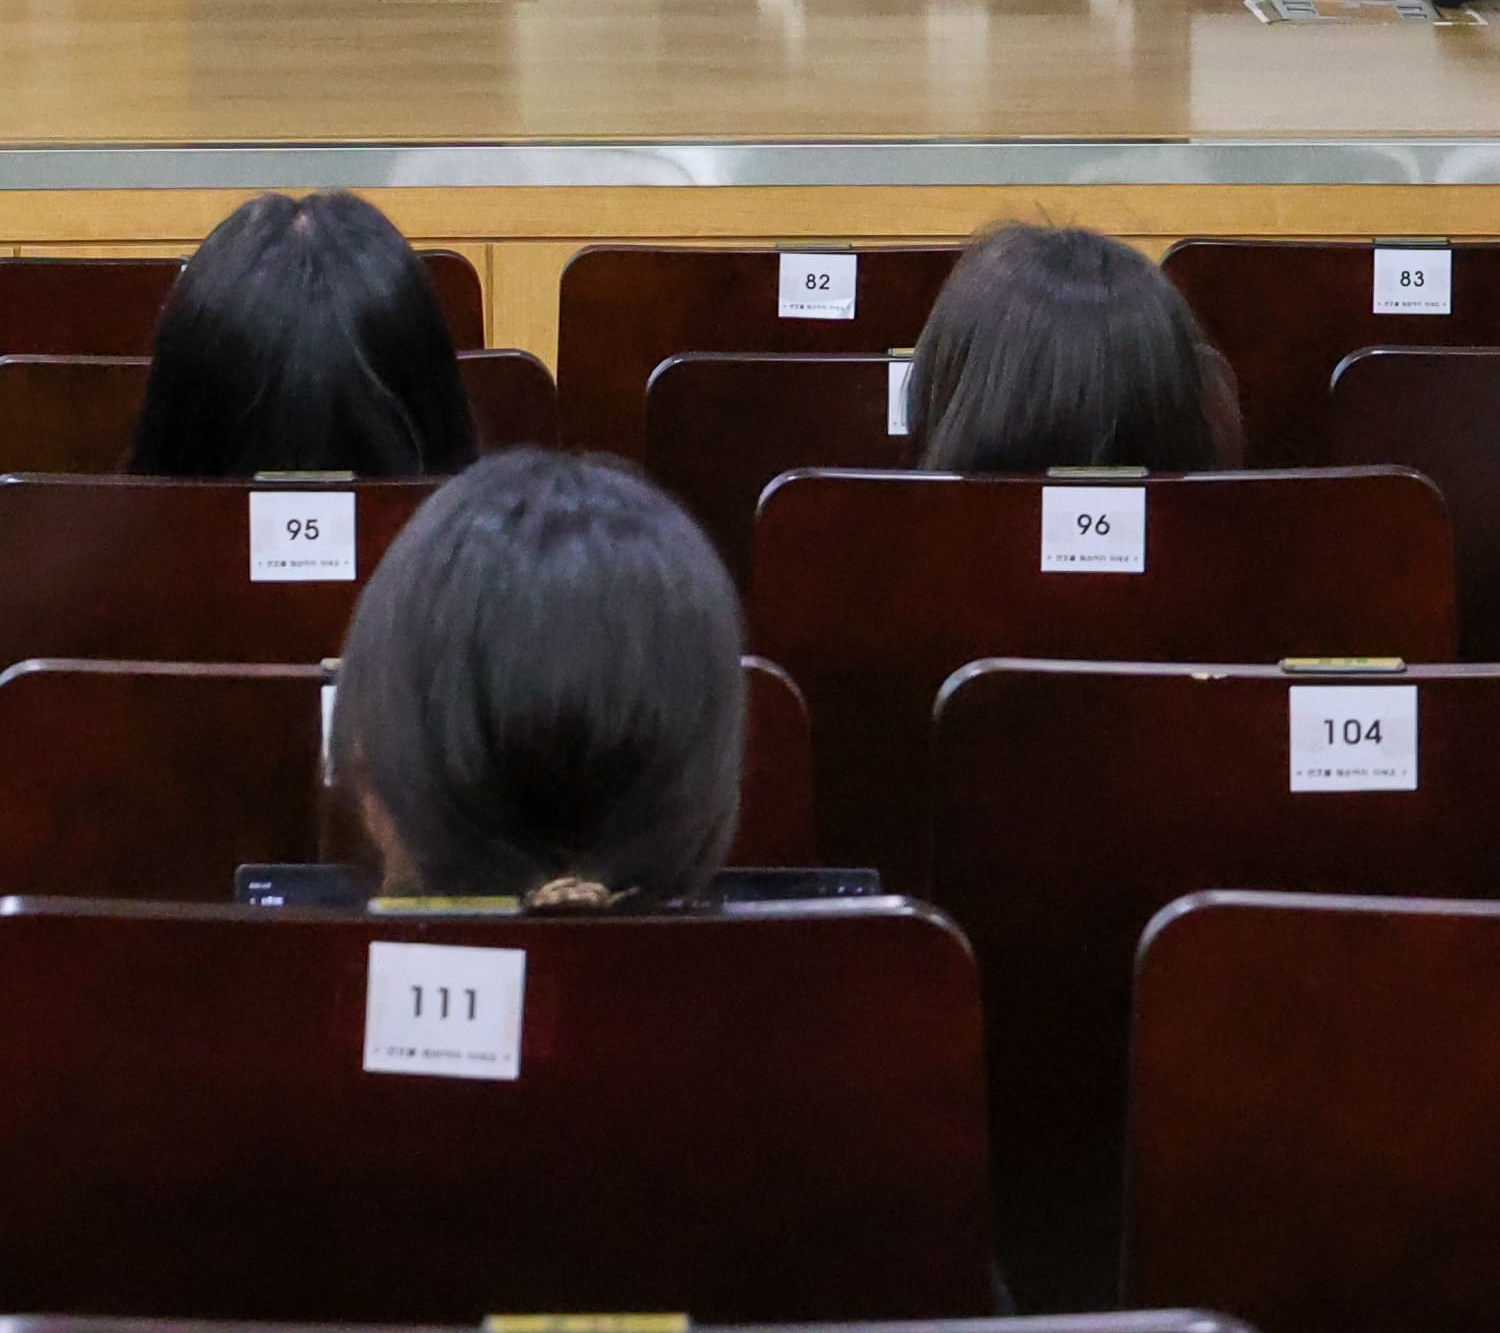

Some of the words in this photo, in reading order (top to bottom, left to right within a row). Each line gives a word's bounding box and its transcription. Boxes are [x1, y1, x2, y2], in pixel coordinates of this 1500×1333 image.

[805, 273, 830, 291] 82
[1400, 271, 1424, 288] 83
[286, 519, 319, 540] 95
[1077, 514, 1110, 536] 96
[1324, 719, 1382, 745] 104
[412, 985, 476, 1020] 111
